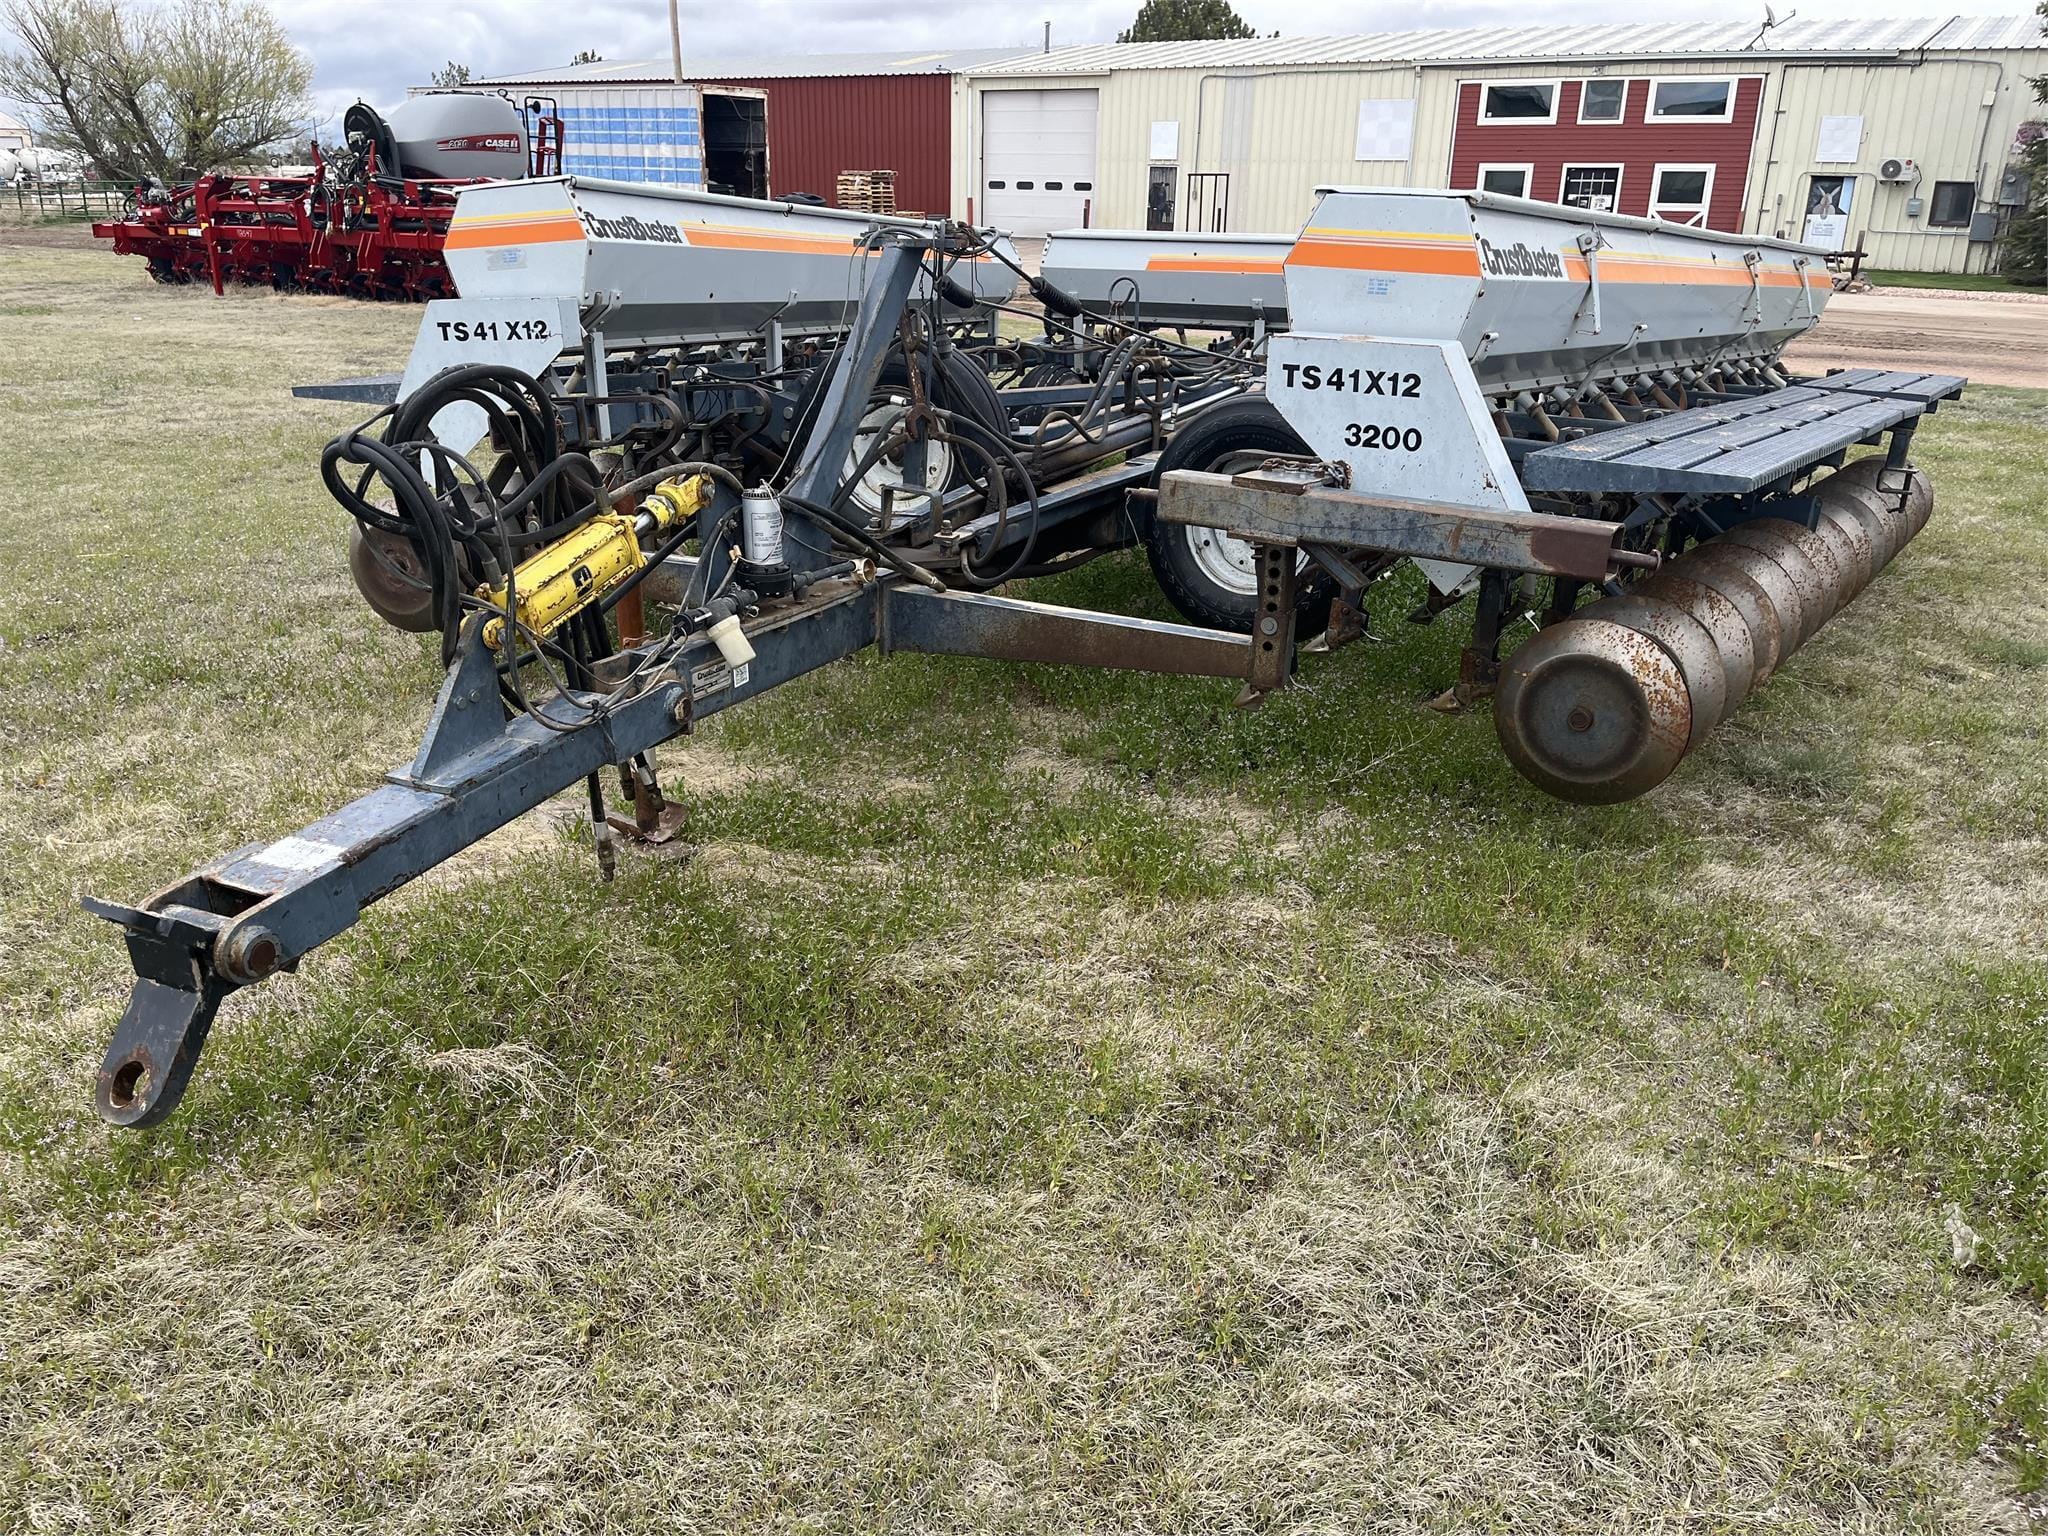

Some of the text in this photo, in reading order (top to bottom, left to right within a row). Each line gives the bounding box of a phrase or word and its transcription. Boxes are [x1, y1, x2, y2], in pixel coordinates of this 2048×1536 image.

[485, 139, 509, 148] CASE
[583, 211, 683, 244] CrustBuster
[1481, 238, 1563, 278] CrustBuster
[1344, 423, 1423, 452] 3200
